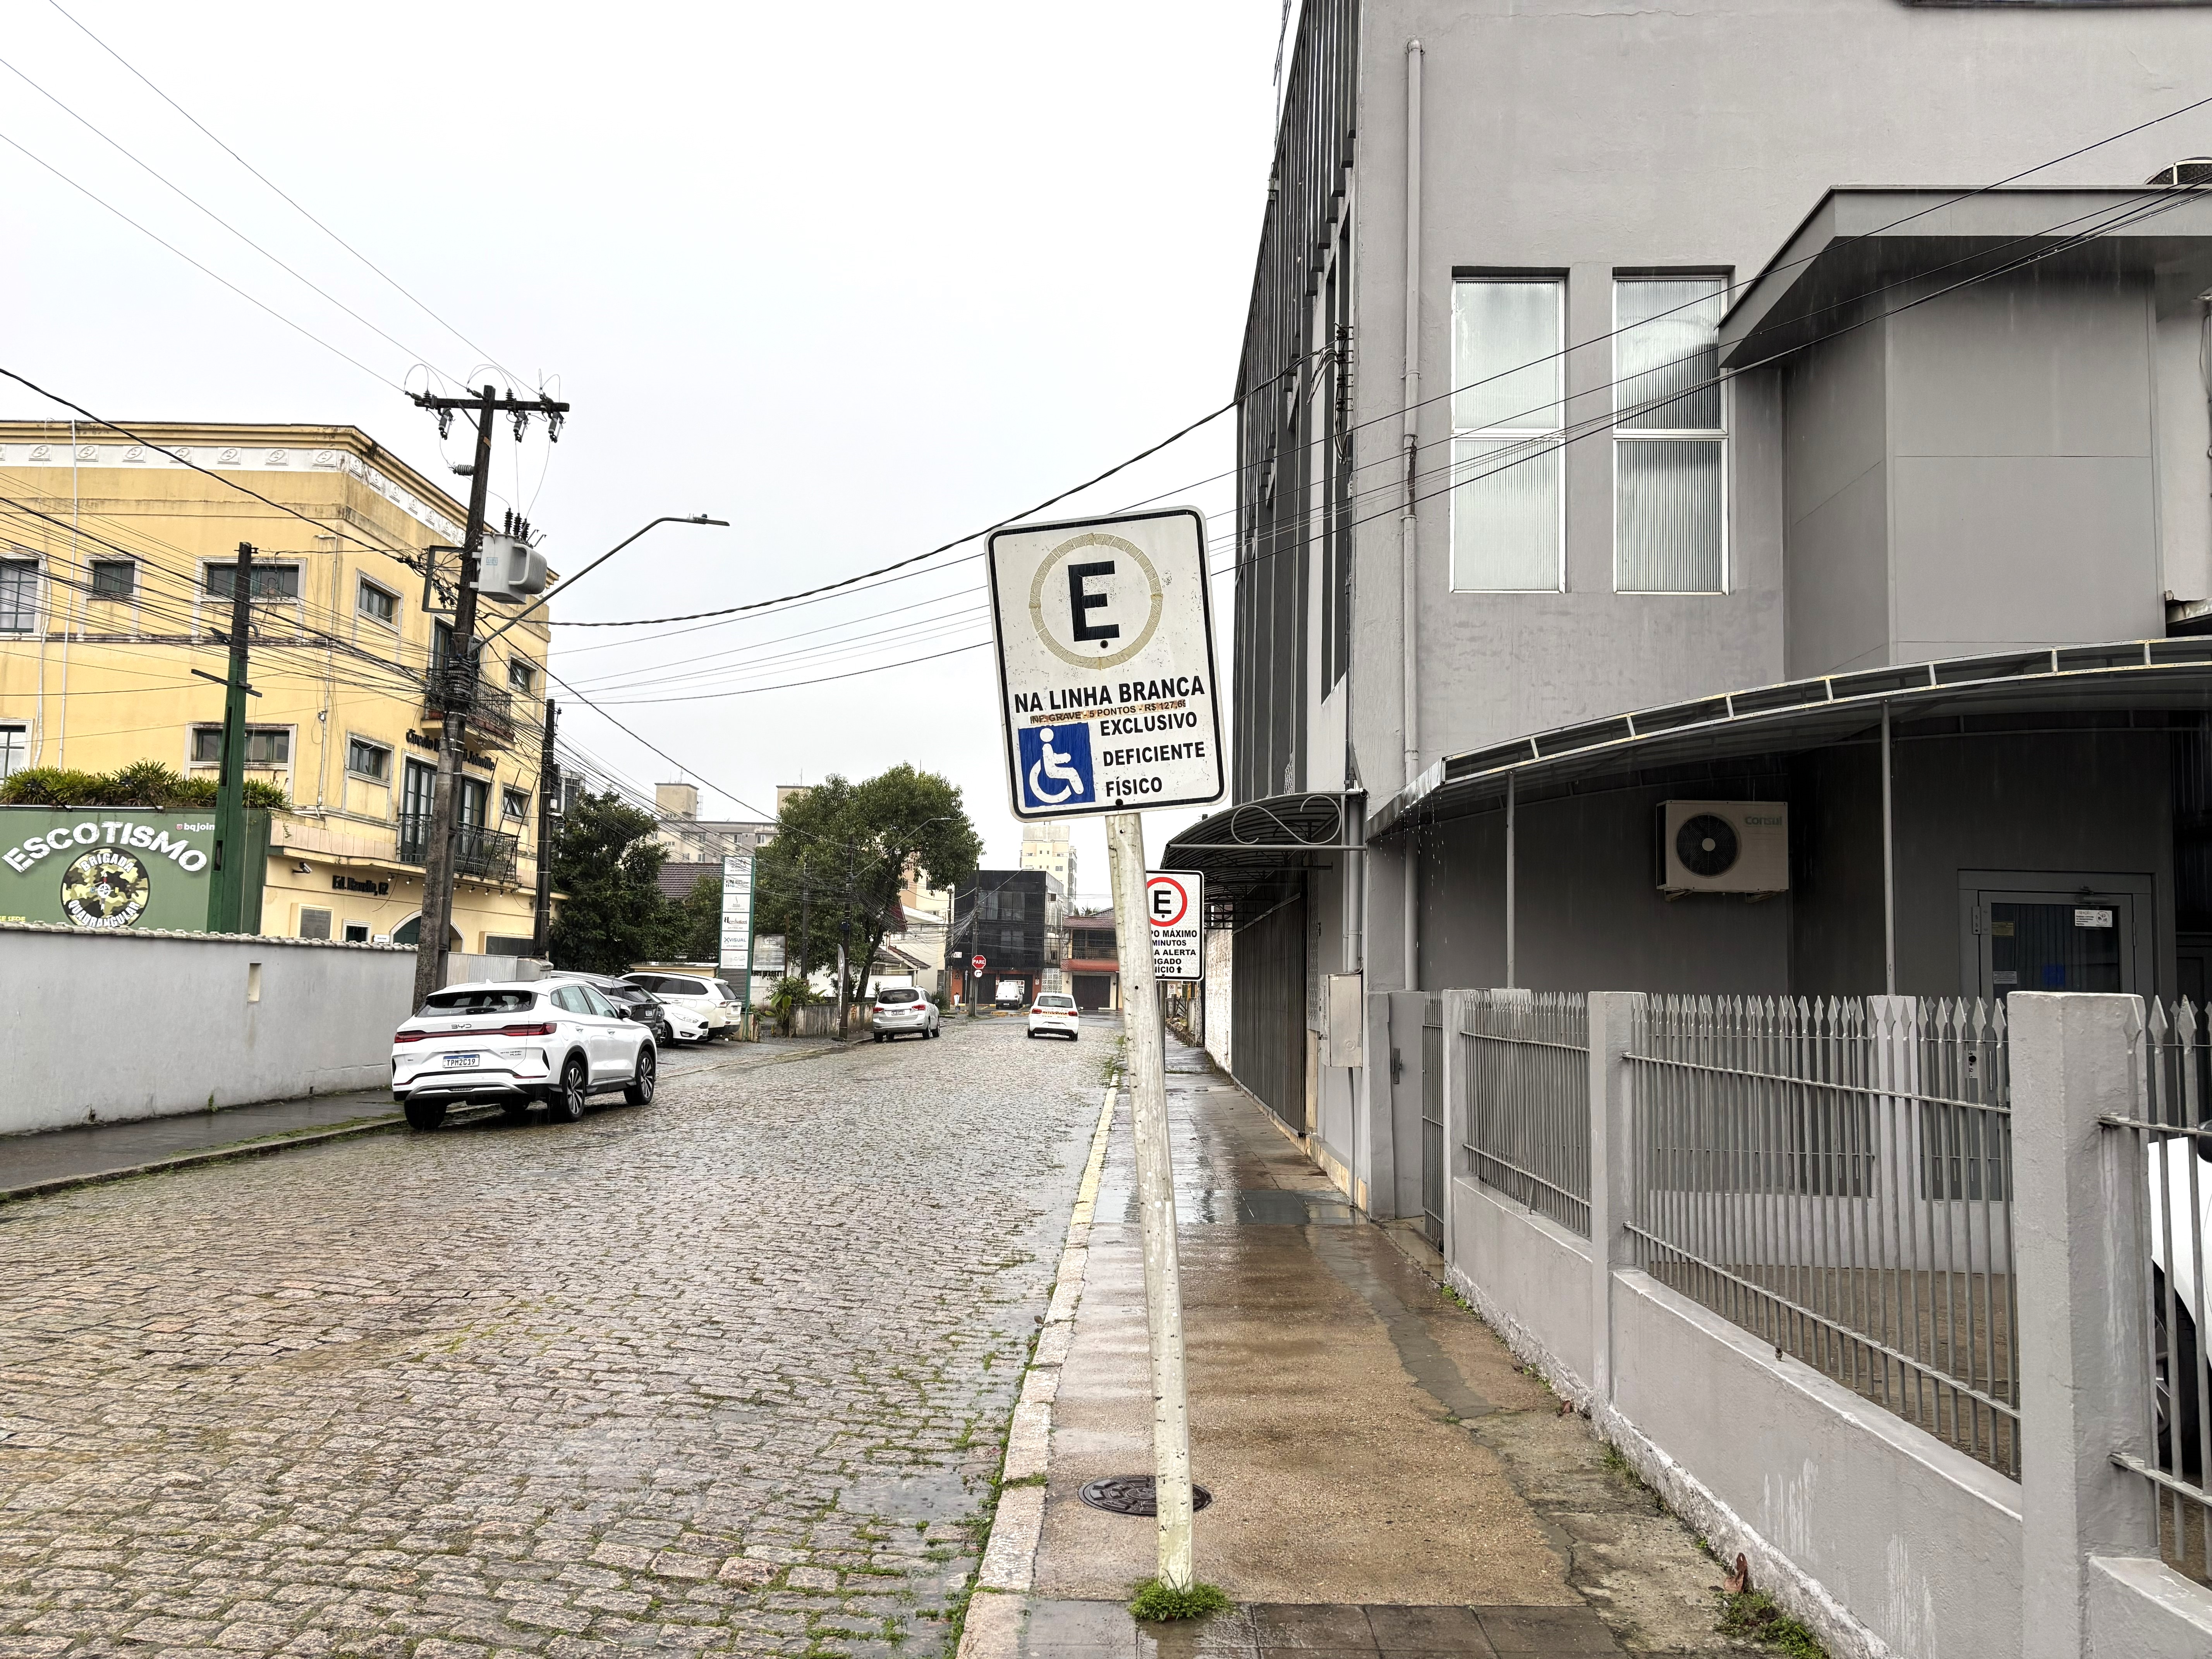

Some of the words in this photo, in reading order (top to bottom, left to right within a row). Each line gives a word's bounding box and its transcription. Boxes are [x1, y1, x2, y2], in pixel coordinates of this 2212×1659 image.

[1068, 560, 1121, 642] E
[1014, 693, 1043, 714] NA
[1049, 685, 1112, 710] LINHA
[1118, 675, 1205, 704] BRANCA
[1047, 711, 1081, 722] GRAVE
[1097, 705, 1136, 717] PONTOS
[1144, 704, 1157, 712] R$
[1100, 712, 1197, 736] EXCLUSIVO
[467, 750, 495, 771] Joinville
[1103, 741, 1206, 767] DEFICIENTE
[1106, 776, 1163, 797] FÍSICO
[1745, 816, 1783, 826] consul
[1, 821, 208, 874] ESCOTISMO
[80, 852, 135, 873] BRIGADA
[68, 899, 141, 927] QUADRANGULAR
[1154, 890, 1171, 914] E
[1163, 928, 1197, 938] MÁXIMO
